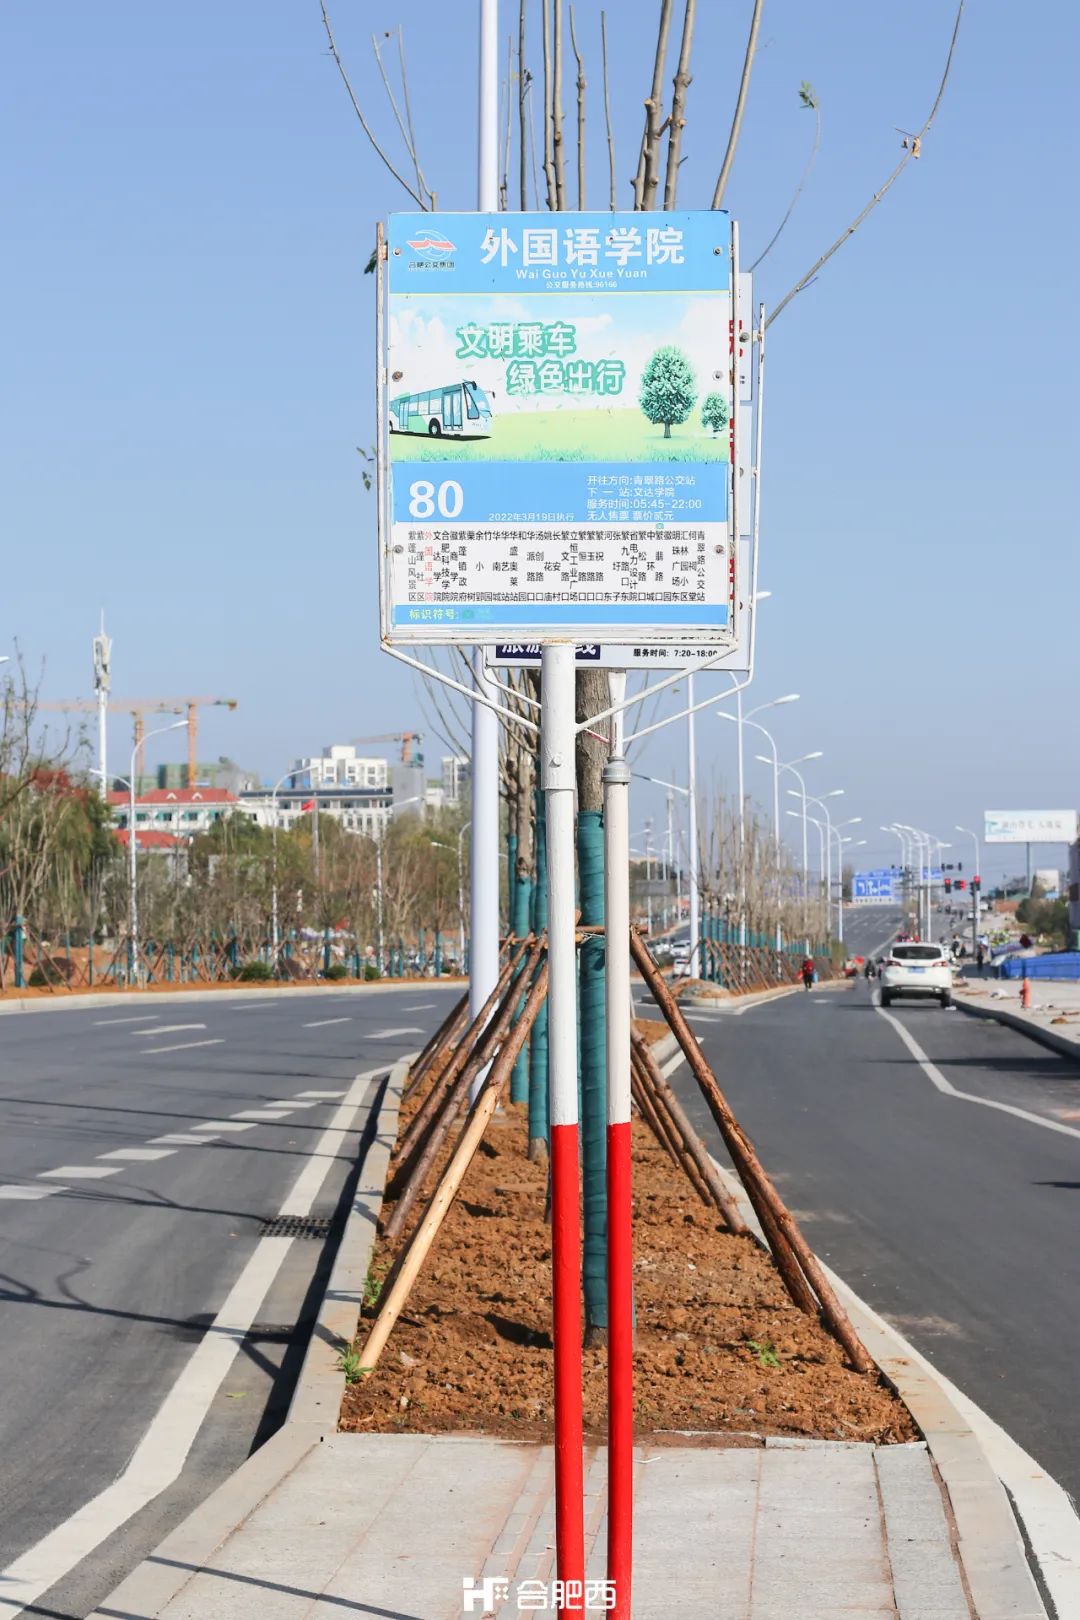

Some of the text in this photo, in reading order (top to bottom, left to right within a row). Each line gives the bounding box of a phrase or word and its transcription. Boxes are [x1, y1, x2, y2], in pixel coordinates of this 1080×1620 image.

[480, 227, 686, 267] 外国语学院
[516, 268, 647, 279] Wai Guo Yu Xue Yuan
[457, 322, 576, 358] 文明乘车
[506, 360, 625, 395] 绿色出行
[408, 480, 464, 518] 80
[587, 499, 703, 509] 服务时间:05:45-22:00
[488, 512, 575, 522] 2022年3月19日执行
[587, 510, 630, 522] 无人售票
[633, 648, 669, 658] 服务时间:
